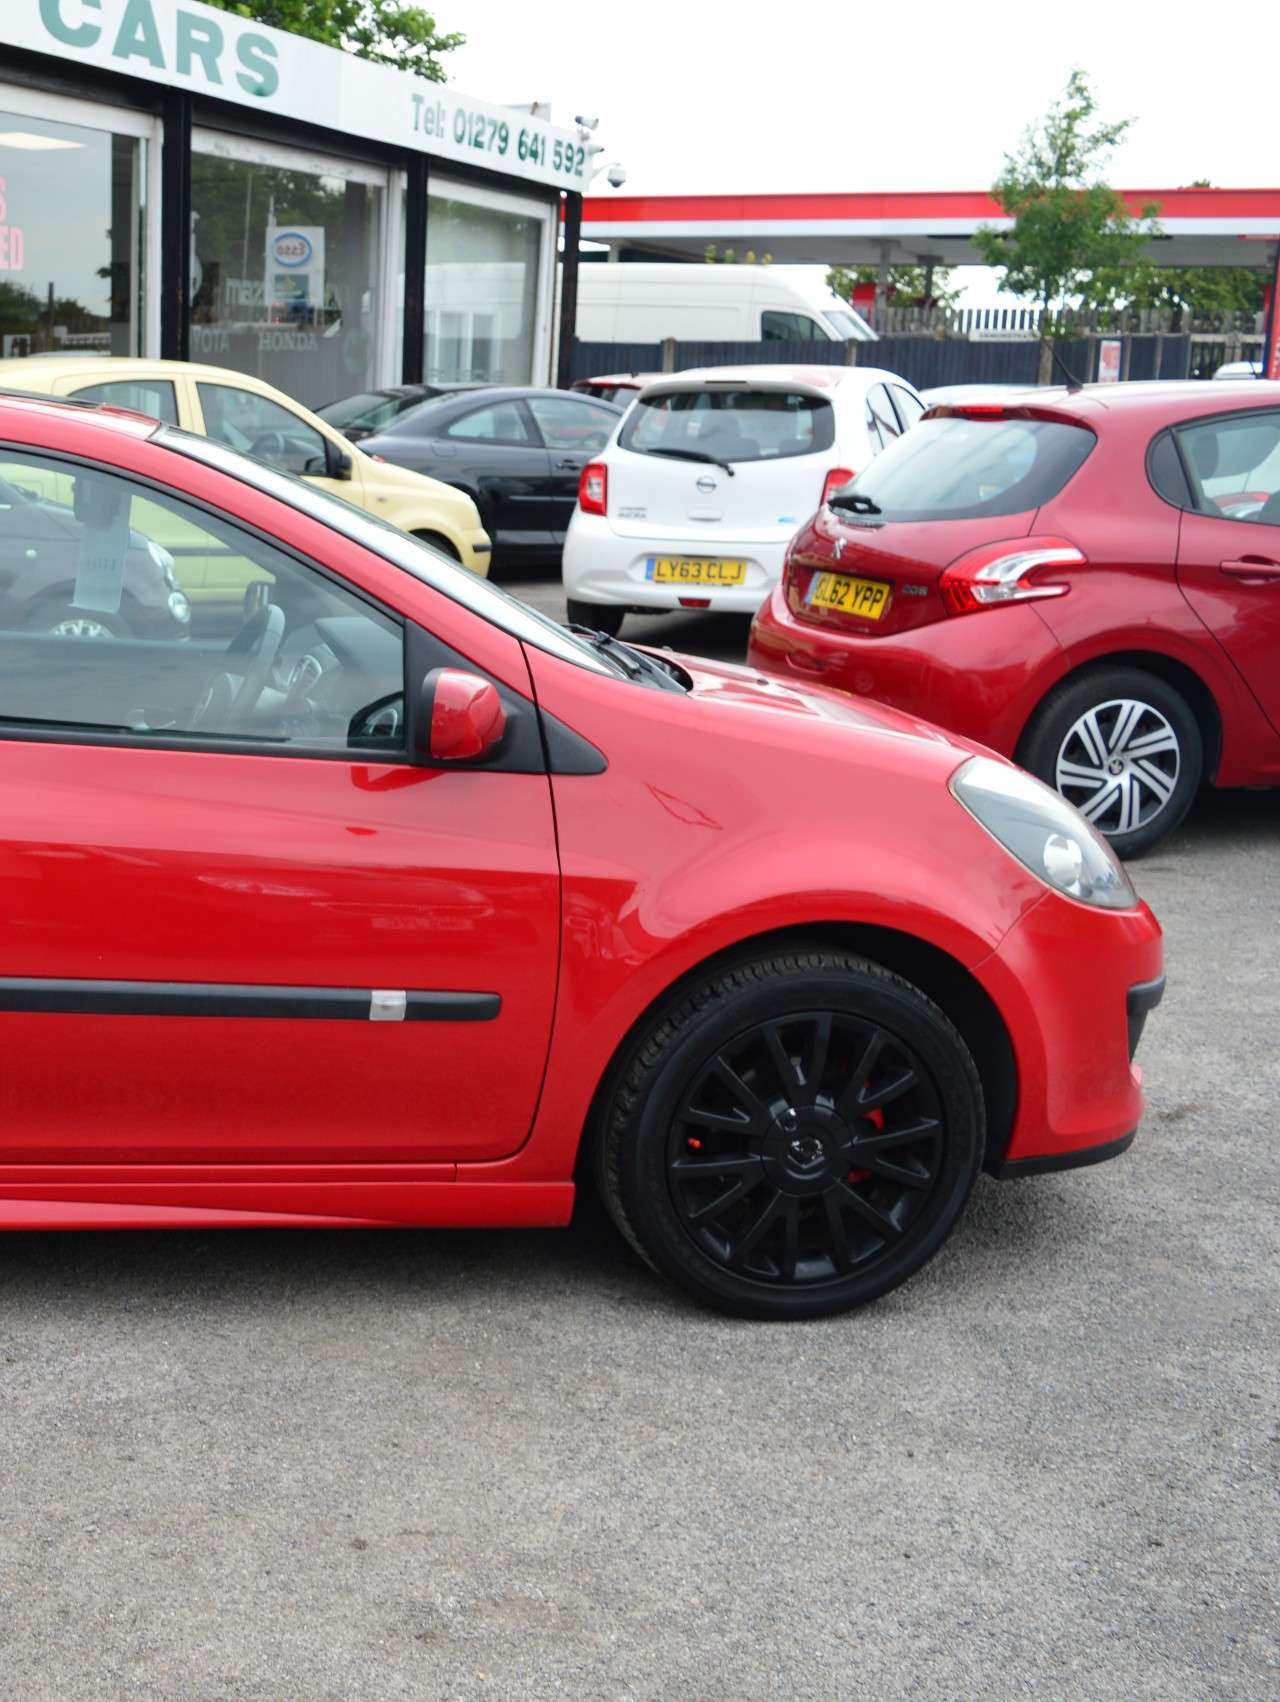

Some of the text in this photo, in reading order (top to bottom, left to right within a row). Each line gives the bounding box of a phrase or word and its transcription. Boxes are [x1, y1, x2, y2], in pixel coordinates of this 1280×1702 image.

[38, 0, 279, 97] CARS
[412, 93, 585, 176] Tel: 01279 641 592
[656, 560, 702, 578] LY63
[852, 583, 884, 613] YPP
